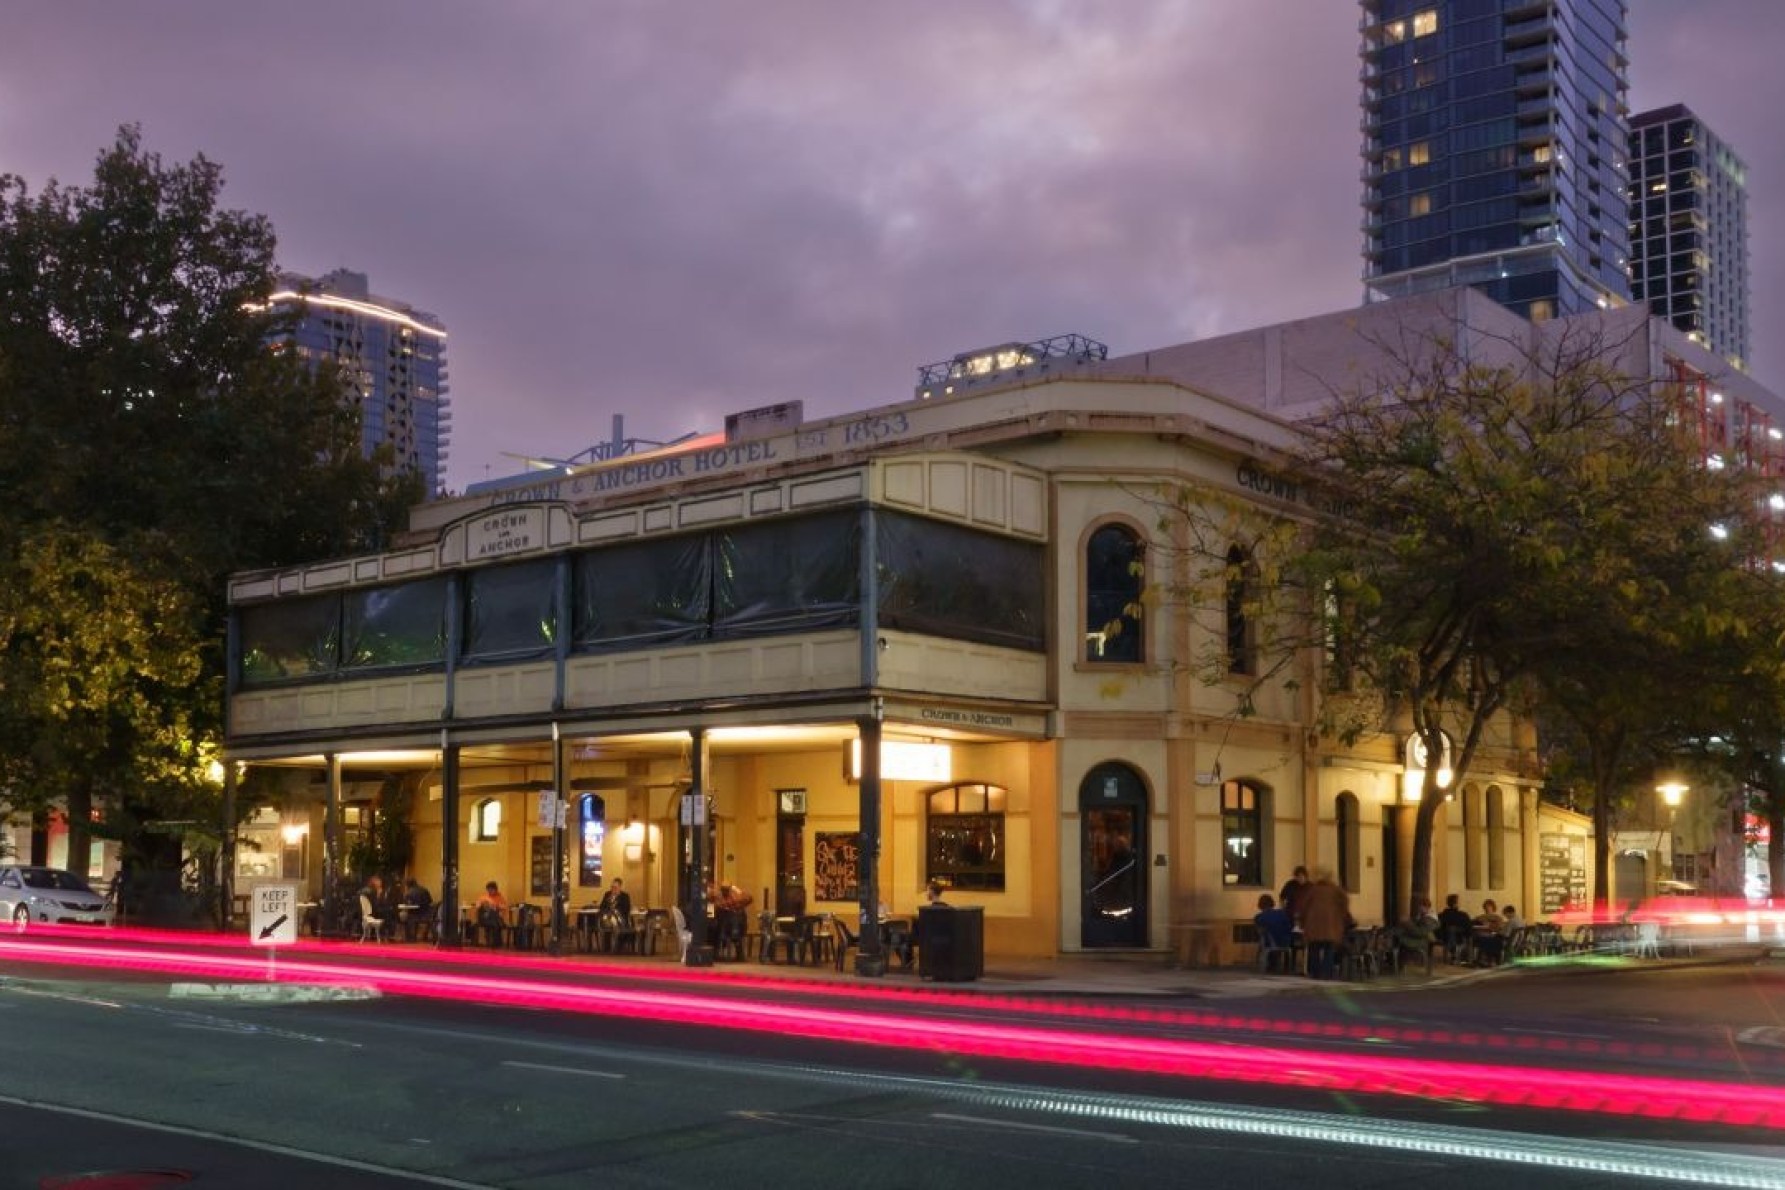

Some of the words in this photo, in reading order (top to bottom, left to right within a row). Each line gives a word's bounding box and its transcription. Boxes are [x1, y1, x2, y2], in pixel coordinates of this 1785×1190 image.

[572, 480, 585, 494] &
[593, 457, 684, 491] ANCHOR
[694, 439, 776, 472] HOTEL
[844, 412, 910, 444] 1853
[1237, 464, 1298, 502] CROWN
[483, 513, 528, 532] CROWN
[480, 535, 530, 553] ANCHOR
[262, 890, 289, 901] KEEP
[262, 902, 287, 913] LEFT
